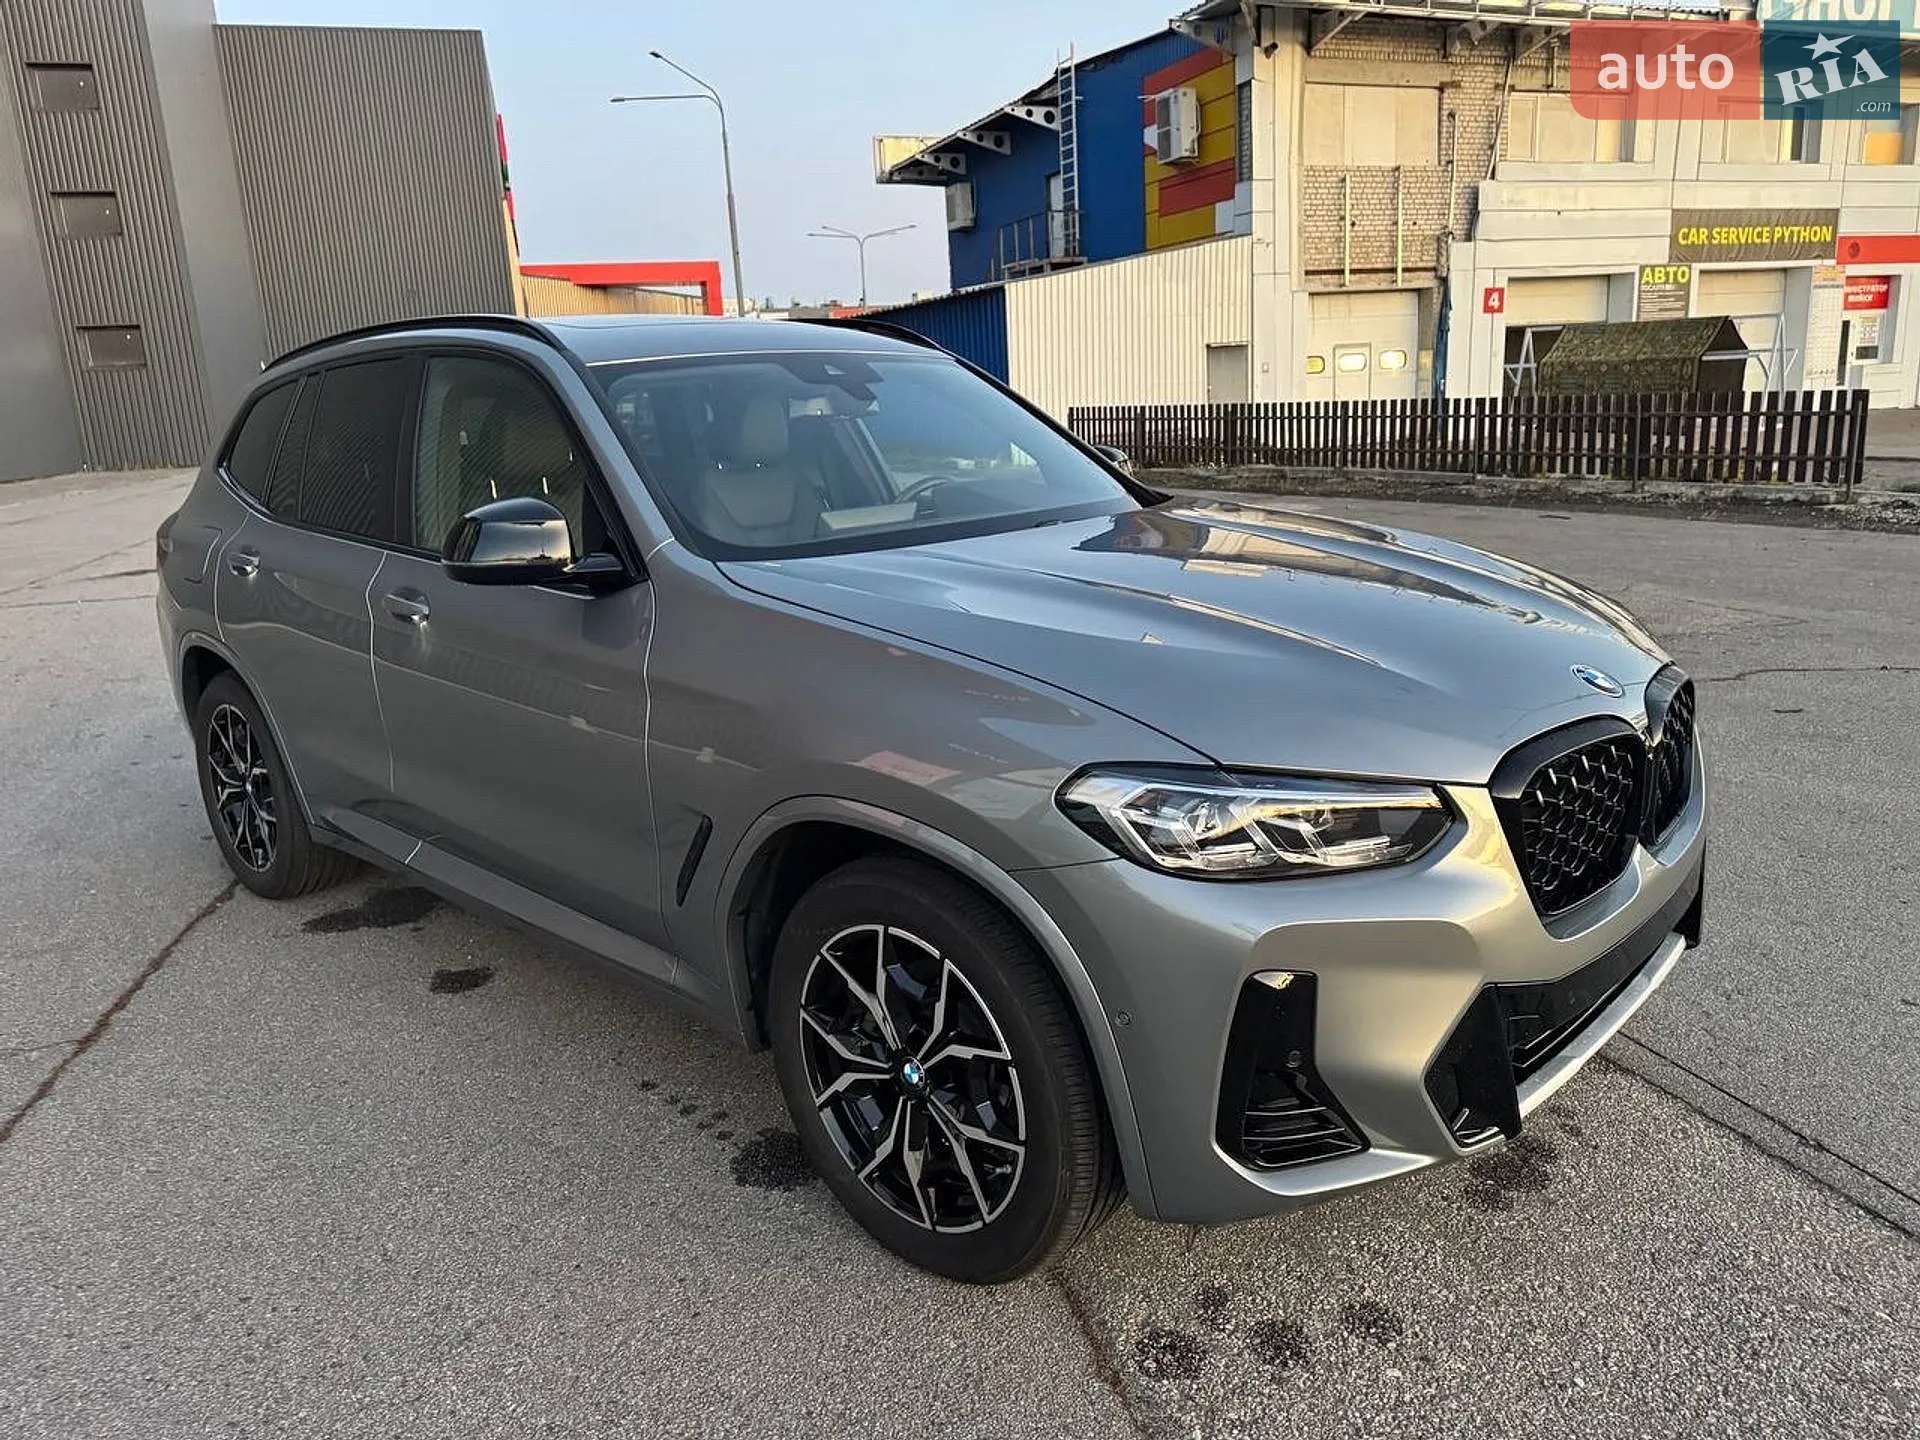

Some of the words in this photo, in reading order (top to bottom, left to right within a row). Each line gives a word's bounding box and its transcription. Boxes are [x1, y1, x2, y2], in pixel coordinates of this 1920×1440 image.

[1678, 228, 1708, 246] CAR
[1711, 227, 1771, 244] SERVICE
[1773, 225, 1833, 243] PYTHON
[1641, 266, 1690, 285] АВТО
[1487, 291, 1501, 309] 4
